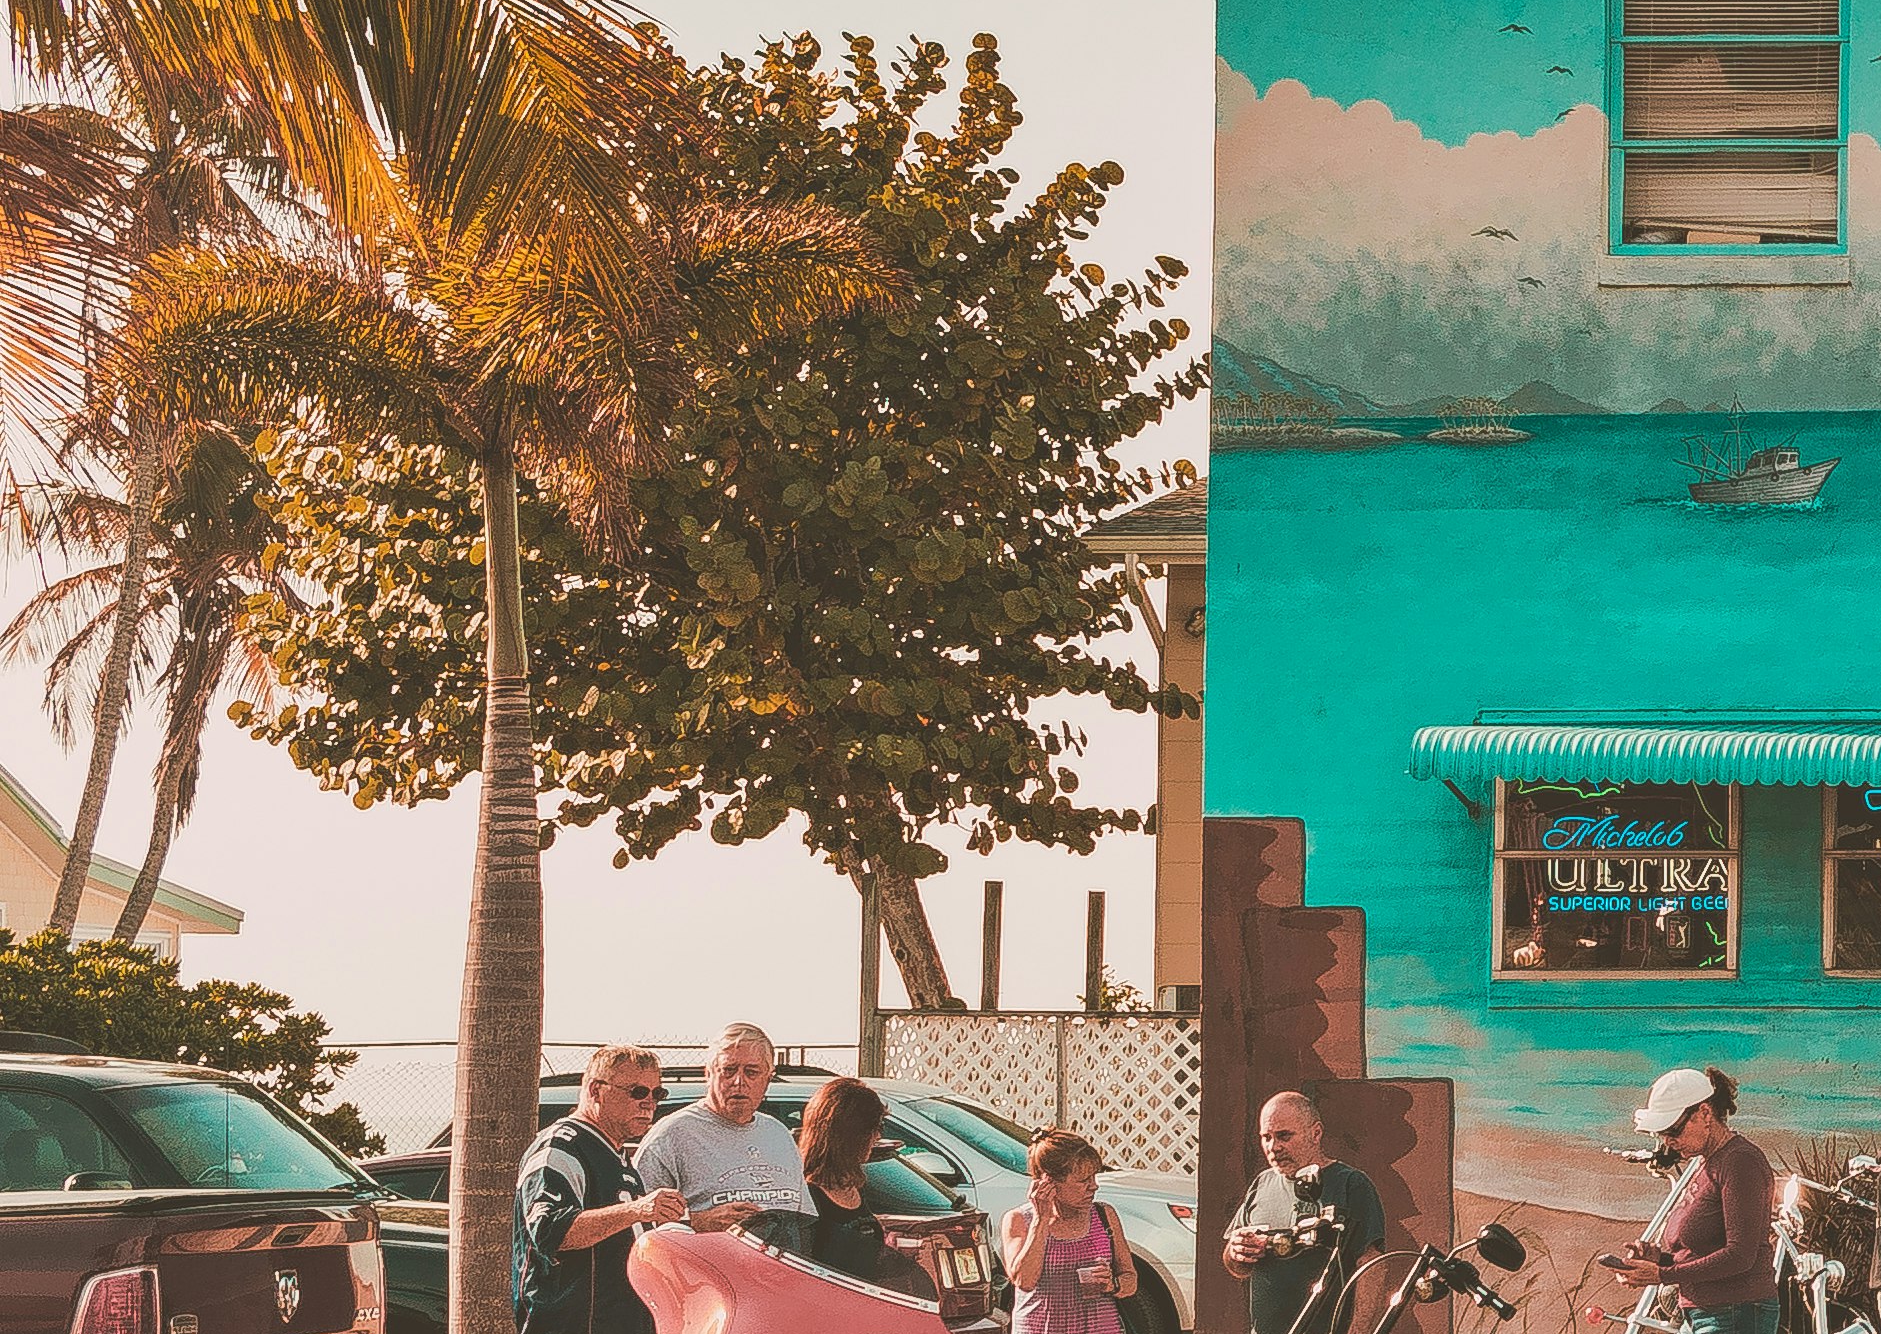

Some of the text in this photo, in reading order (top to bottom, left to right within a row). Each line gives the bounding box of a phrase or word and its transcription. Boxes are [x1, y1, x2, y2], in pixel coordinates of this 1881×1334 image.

[1542, 814, 1689, 850] Michelob
[1547, 858, 1729, 893] ULTRA
[1548, 896, 1632, 912] SUPERIOR
[1638, 896, 1687, 912] LIGHT
